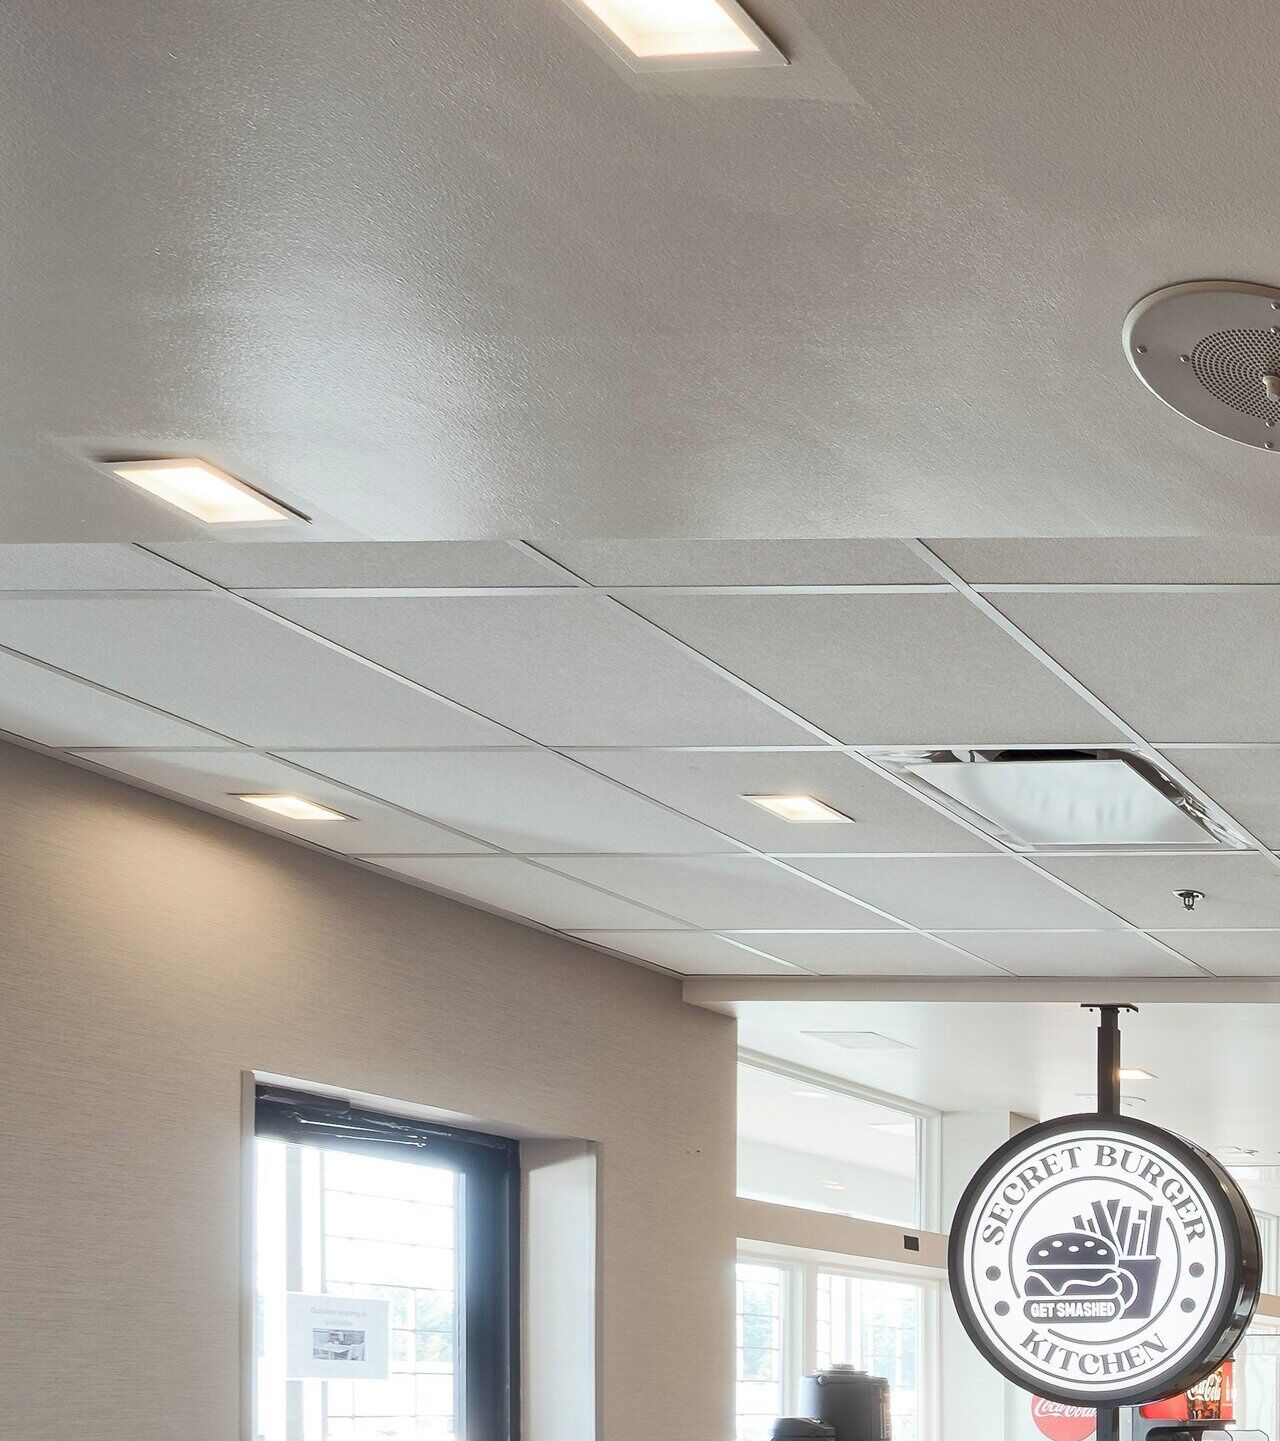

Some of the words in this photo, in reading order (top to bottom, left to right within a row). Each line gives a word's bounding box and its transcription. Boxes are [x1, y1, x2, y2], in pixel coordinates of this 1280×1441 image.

[982, 1146, 1082, 1246] SECRET
[1094, 1144, 1206, 1244] BURGER
[1030, 1303, 1055, 1318] GET
[1057, 1301, 1116, 1317] SMASHED
[1019, 1329, 1169, 1376] KITCHEN
